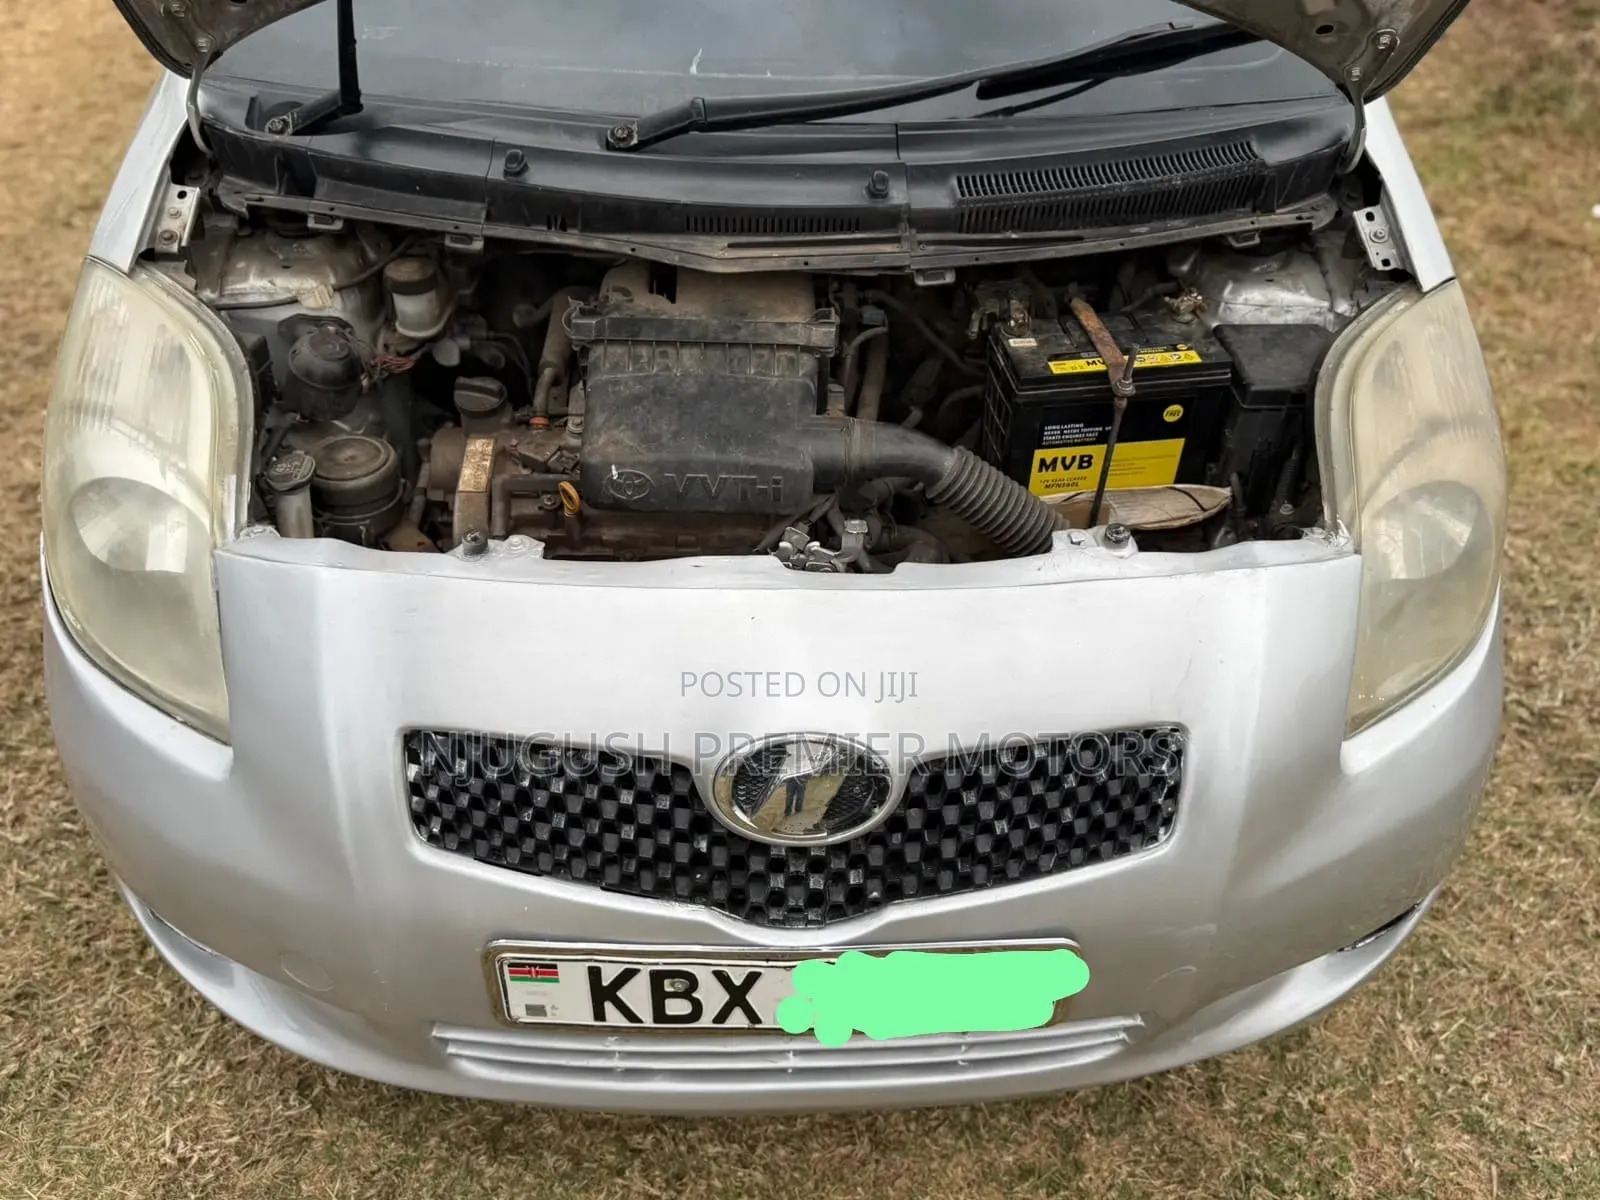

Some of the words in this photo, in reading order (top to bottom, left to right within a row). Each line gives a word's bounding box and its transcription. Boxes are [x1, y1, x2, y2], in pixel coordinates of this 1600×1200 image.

[1061, 422, 1084, 430] LASTING
[1038, 454, 1094, 473] MVB
[663, 473, 783, 502] VVT-i
[587, 965, 763, 1025] KBX
